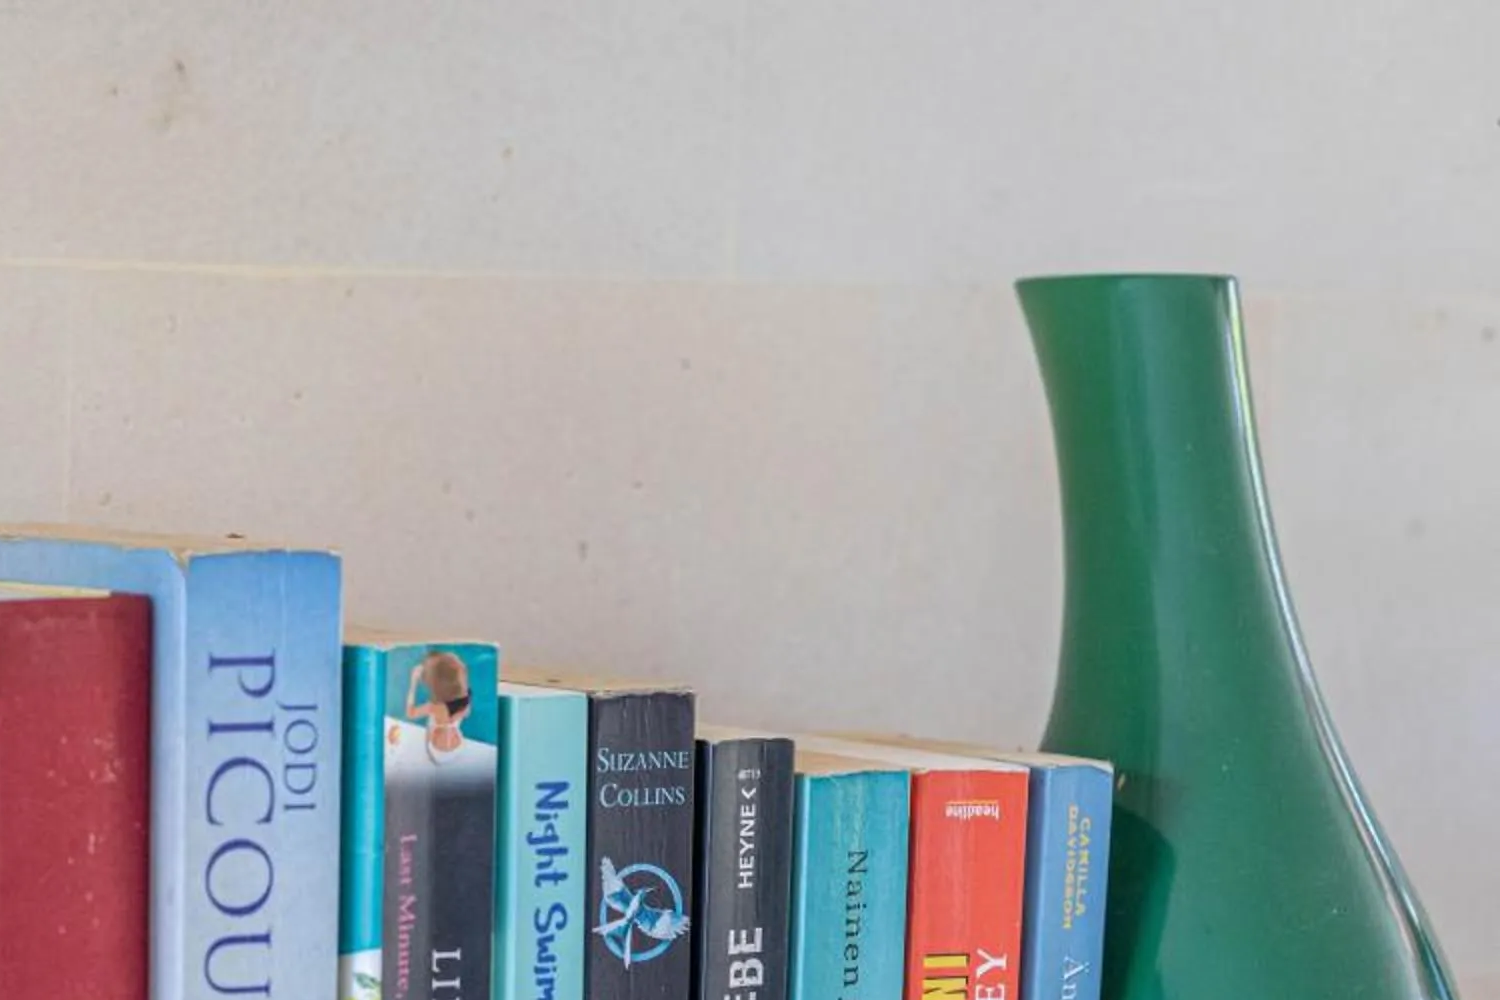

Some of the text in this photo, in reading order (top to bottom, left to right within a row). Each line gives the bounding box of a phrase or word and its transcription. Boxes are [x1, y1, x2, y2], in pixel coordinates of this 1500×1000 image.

[276, 702, 318, 810] JODI
[597, 747, 689, 773] SUZANNE
[600, 783, 685, 808] COLLINS
[399, 833, 418, 886] Last
[527, 780, 570, 888] Night
[842, 849, 869, 988] Nainen
